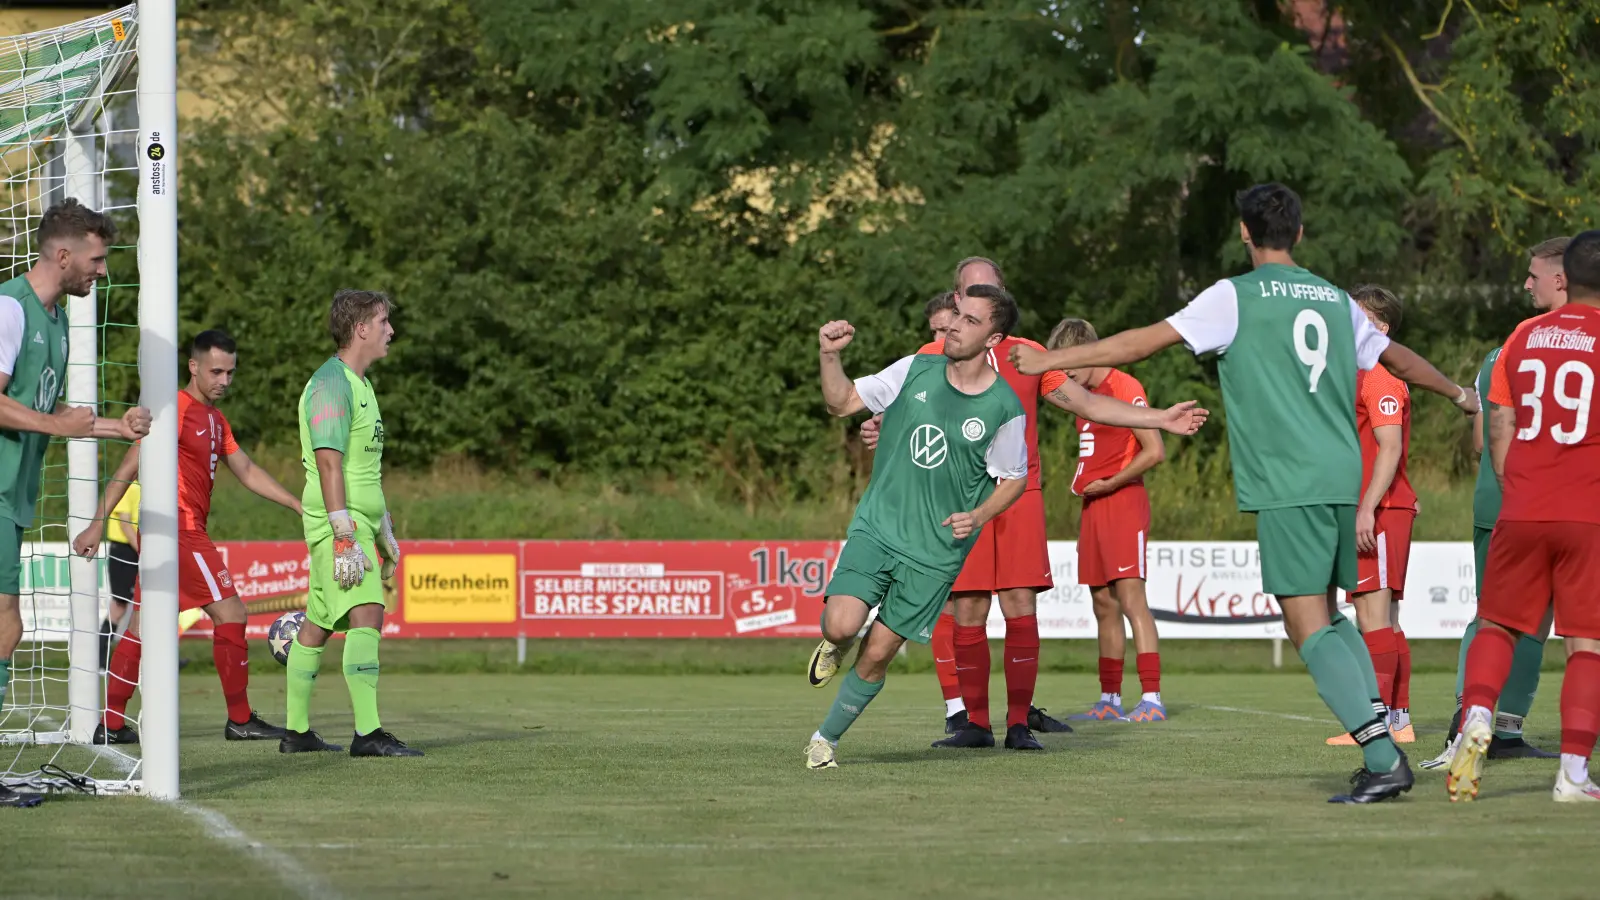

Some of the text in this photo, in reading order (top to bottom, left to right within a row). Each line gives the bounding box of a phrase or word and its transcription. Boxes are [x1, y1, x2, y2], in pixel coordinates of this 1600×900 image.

[149, 131, 161, 142] de
[150, 162, 161, 195] anstoss
[1270, 280, 1287, 297] FV
[1292, 308, 1329, 393] 9
[1525, 331, 1597, 353] DINKELSBÜHL
[1517, 358, 1595, 445] 39
[247, 560, 268, 577] da
[272, 560, 298, 574] wo
[410, 573, 509, 590] Uffenheim
[534, 578, 593, 594] SELBER
[597, 578, 671, 594] MISCHEN
[674, 578, 711, 593] UND
[534, 595, 608, 614] BARES
